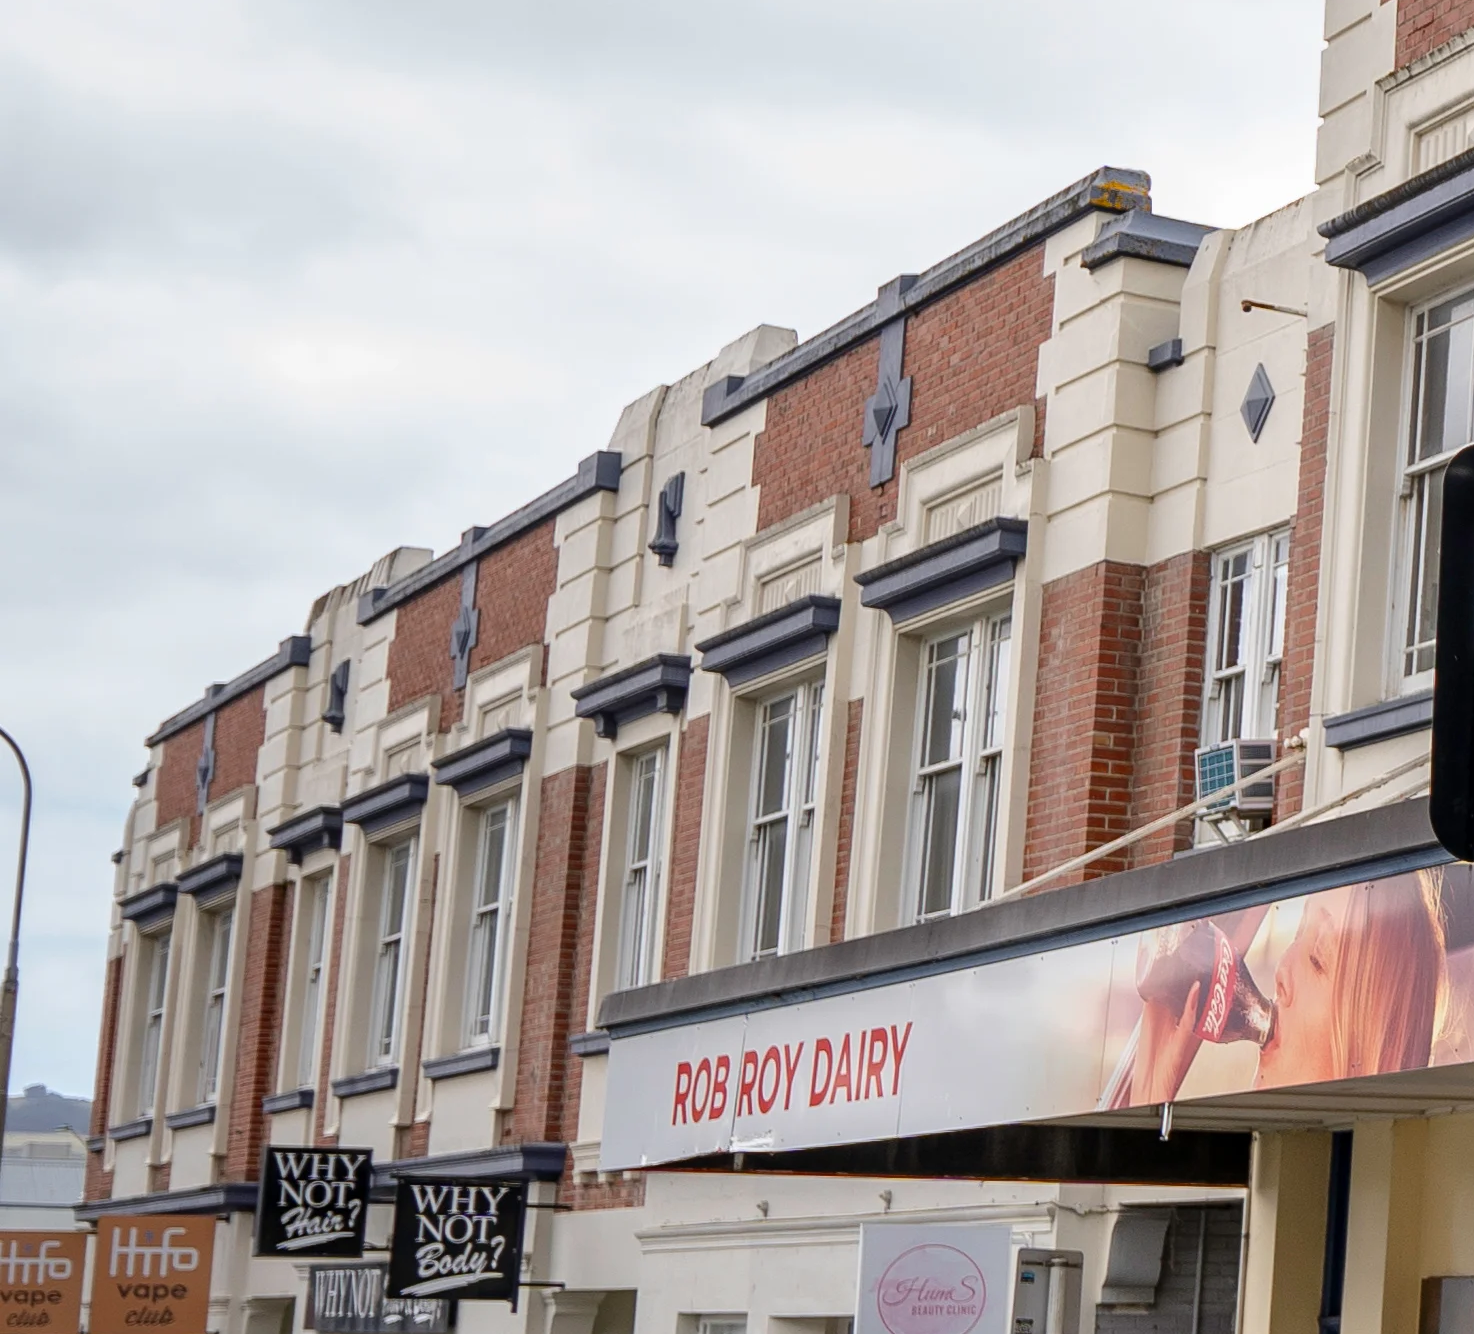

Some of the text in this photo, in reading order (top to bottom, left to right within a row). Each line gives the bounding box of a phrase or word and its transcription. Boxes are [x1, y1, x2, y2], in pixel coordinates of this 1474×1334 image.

[671, 1021, 913, 1126] ROB ROY DAIRY
[273, 1151, 368, 1181] WHY
[276, 1180, 356, 1208] NOT
[410, 1184, 509, 1215] WHY
[281, 1198, 362, 1239] Hair?
[415, 1214, 498, 1244] NOT
[416, 1235, 505, 1279] Body?
[0, 1288, 62, 1307] vape
[117, 1283, 188, 1303] vape
[315, 1269, 345, 1318] WHY
[346, 1269, 381, 1318] NOT
[6, 1309, 52, 1327] club
[125, 1306, 176, 1327] club
[912, 1304, 977, 1316] BEAUTY CLINIC
